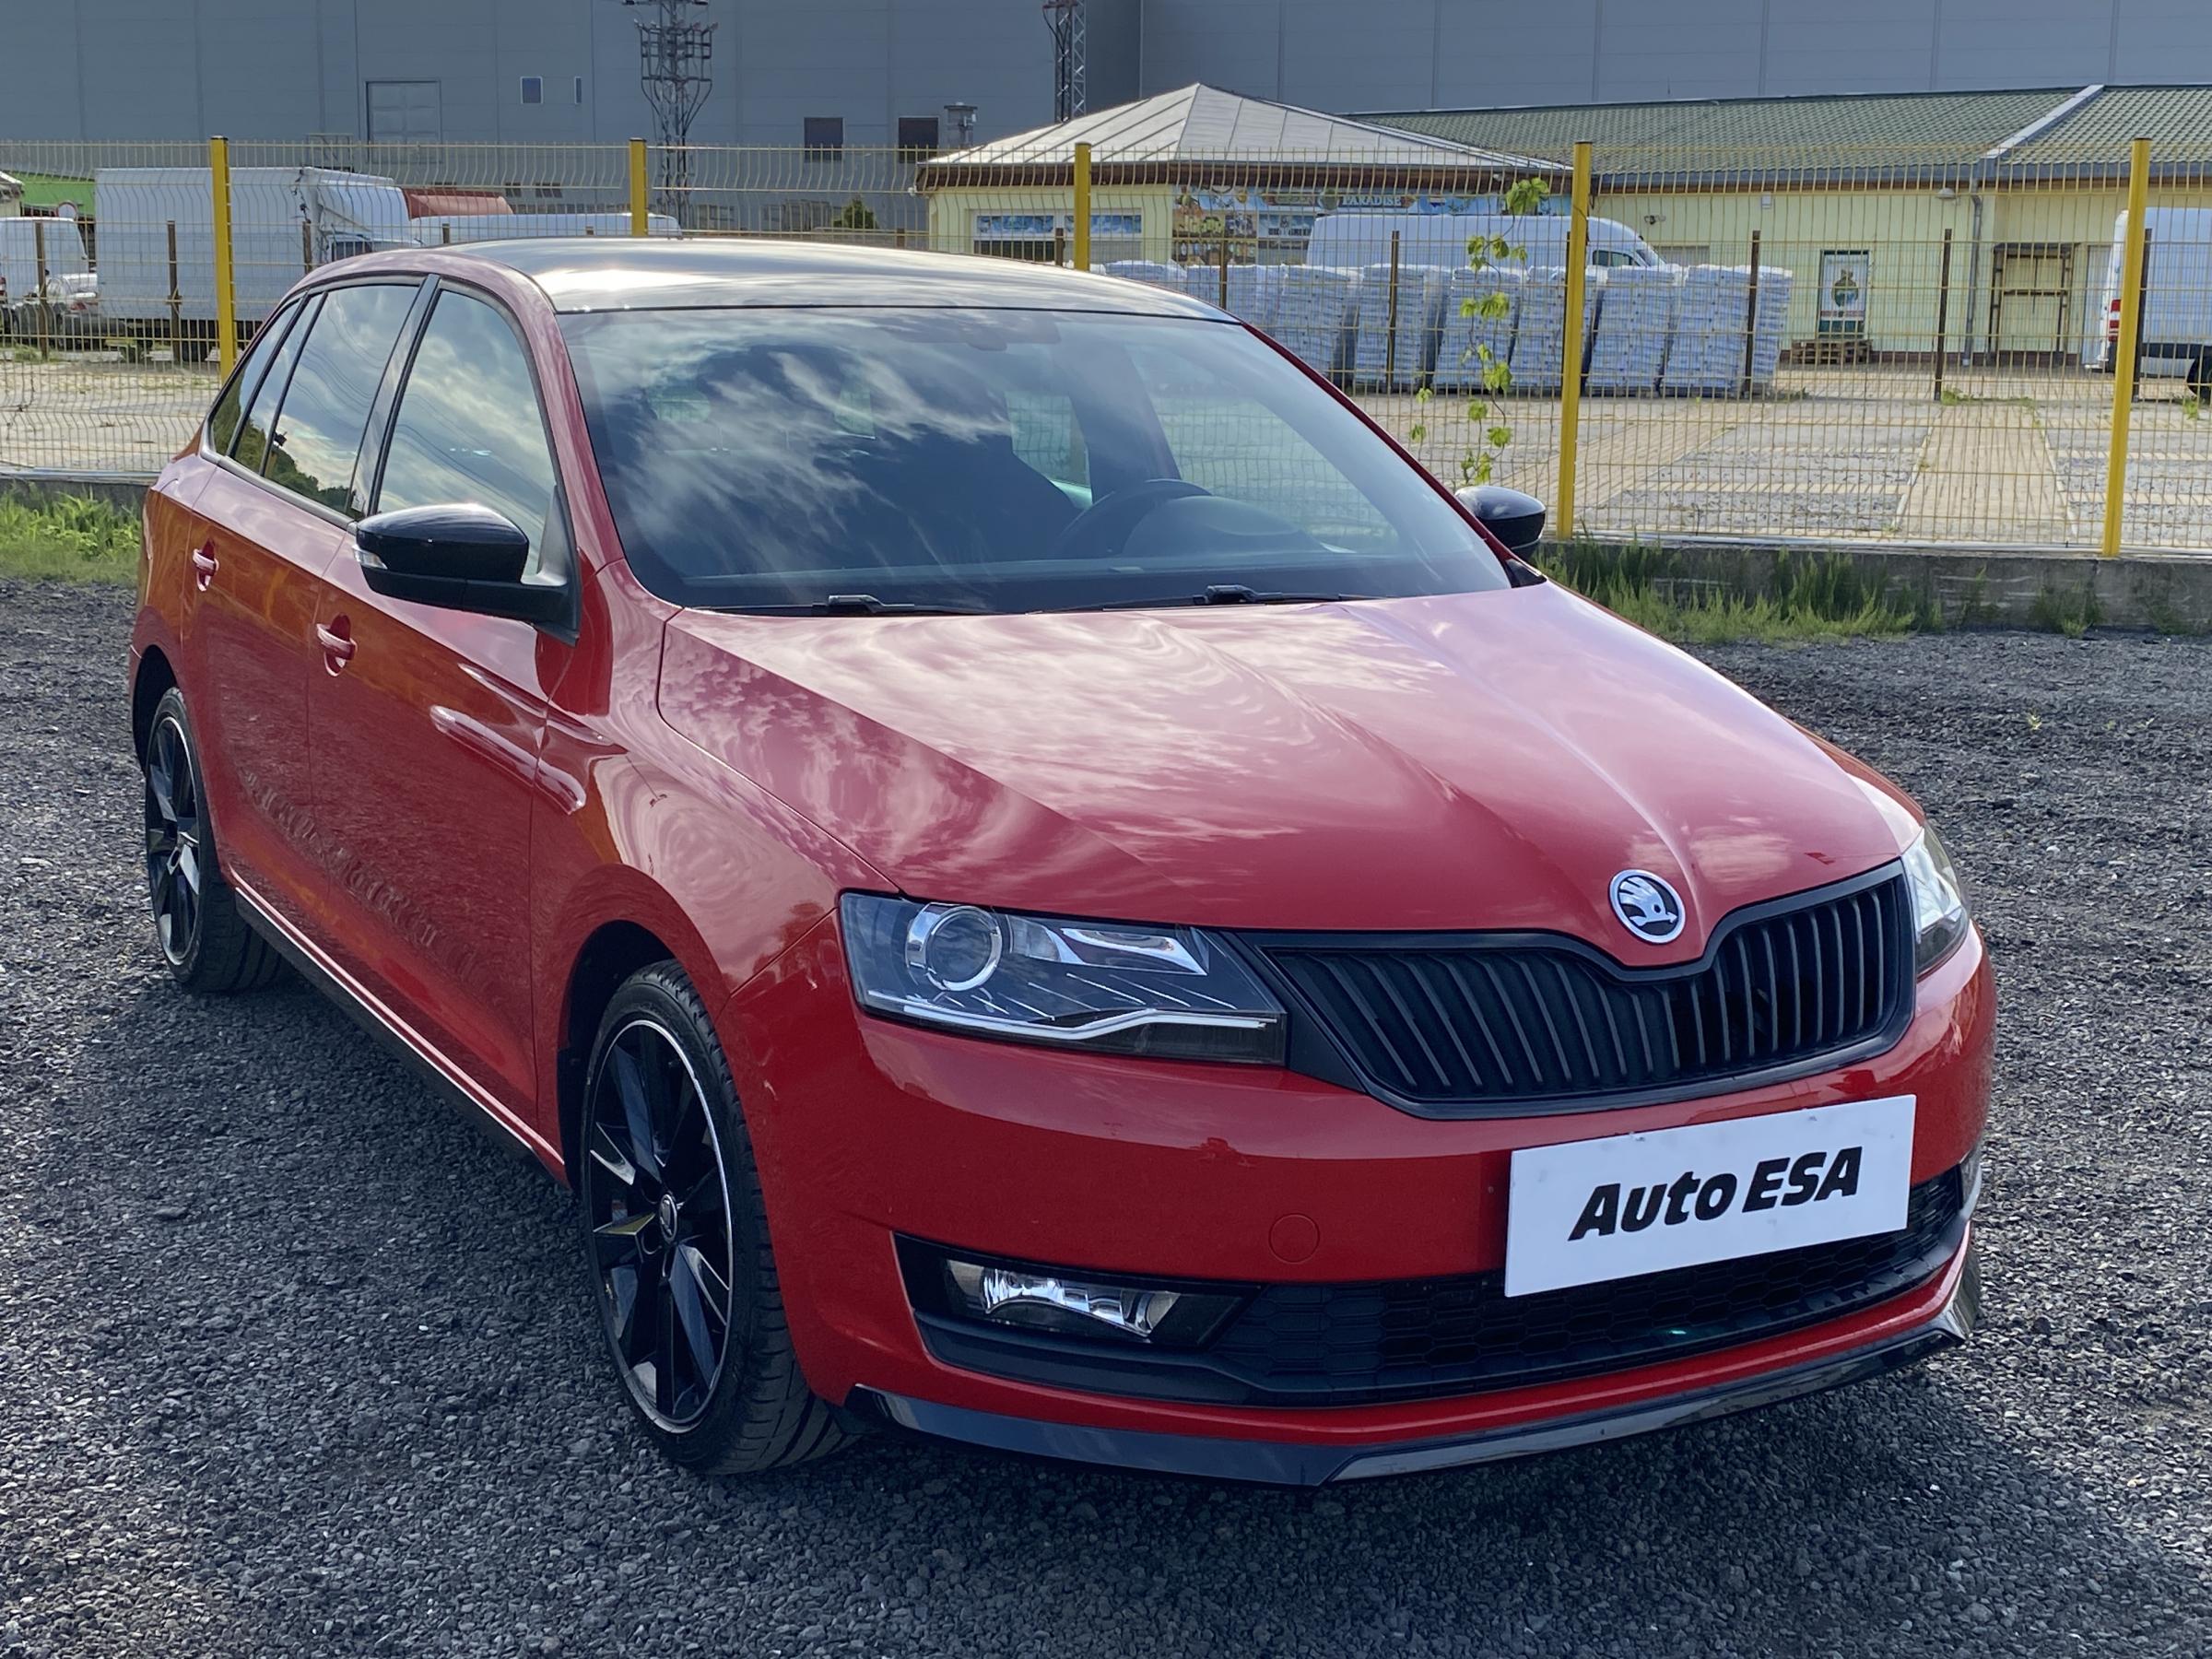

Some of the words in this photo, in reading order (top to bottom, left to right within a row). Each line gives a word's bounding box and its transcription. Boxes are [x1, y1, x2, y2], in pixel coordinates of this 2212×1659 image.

[1342, 194, 1401, 206] PARADISE
[1567, 1171, 1737, 1241] Auto
[1742, 1146, 1863, 1213] ESA
